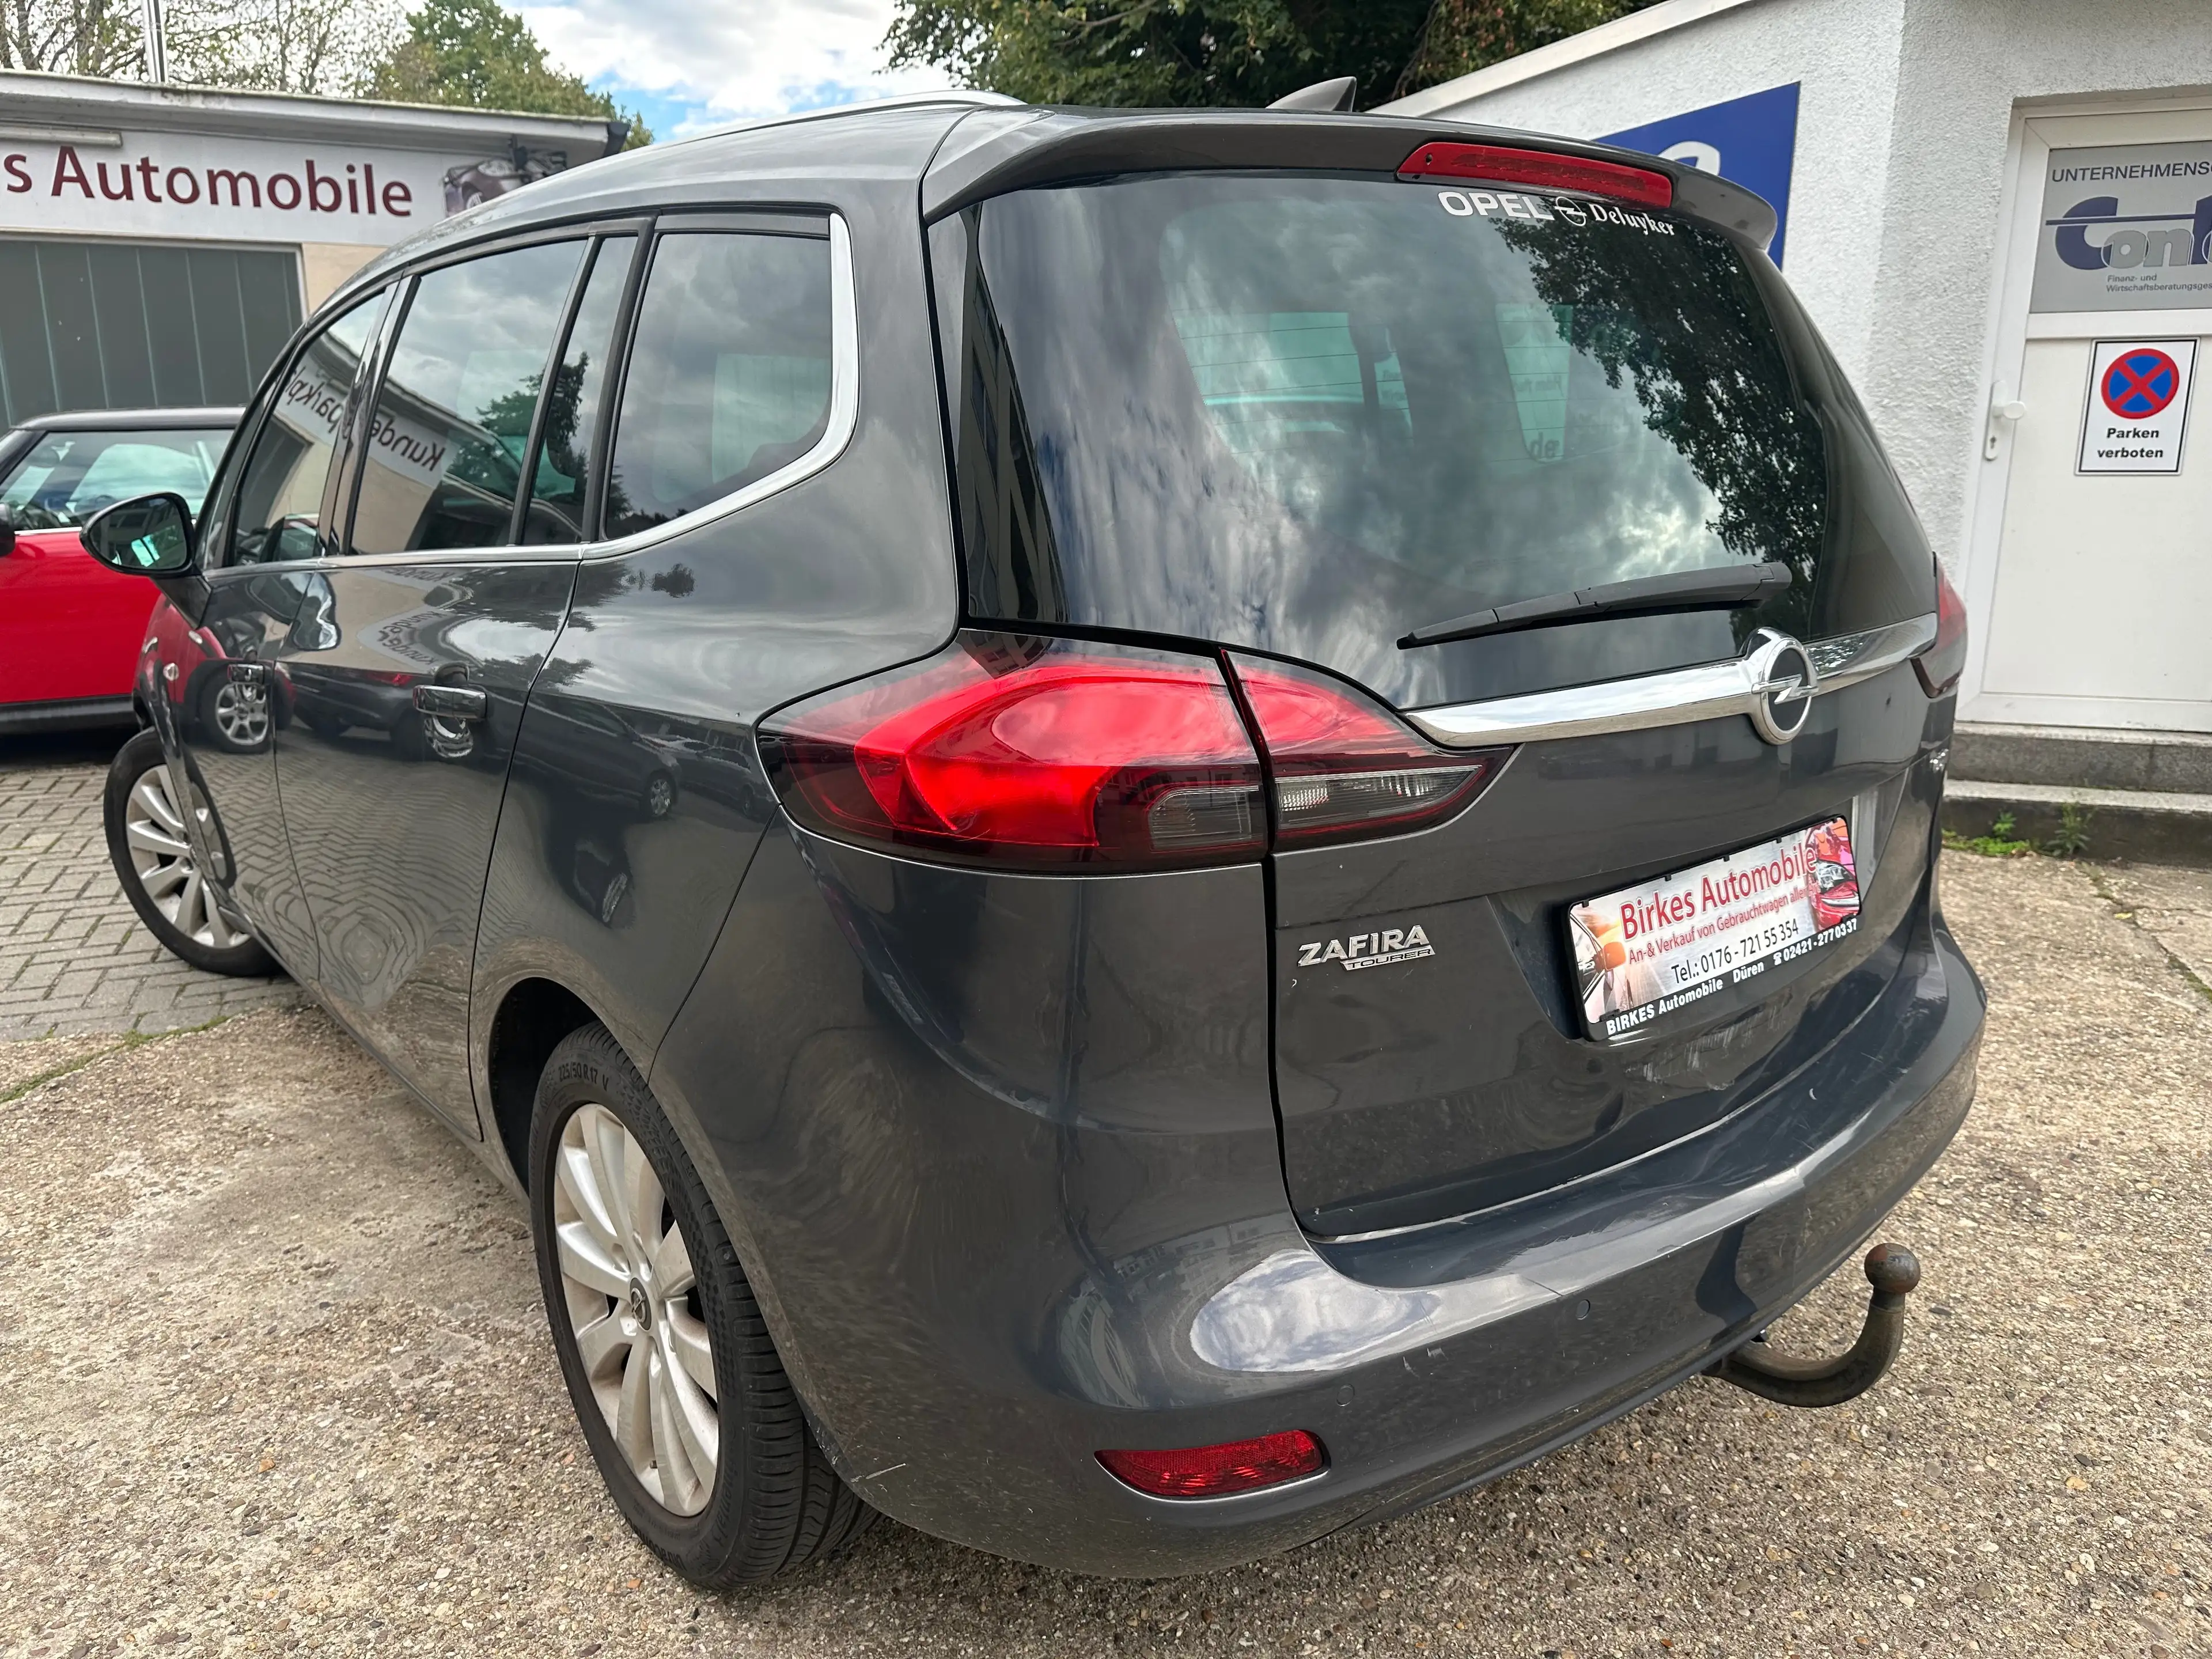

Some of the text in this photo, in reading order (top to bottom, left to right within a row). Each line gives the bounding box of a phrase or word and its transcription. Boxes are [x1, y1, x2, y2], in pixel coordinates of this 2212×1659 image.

[51, 145, 412, 217] Automobile
[2052, 161, 2212, 182] UNTERNEHMENS
[1438, 191, 1675, 236] OPEL Deluyker
[2107, 274, 2157, 283] Finanz- und
[2097, 447, 2164, 458] verboten
[2107, 427, 2160, 438] Parken
[1620, 842, 1816, 940] Birkes Automobile
[1656, 926, 1695, 953] Verkauf
[1697, 923, 1715, 938] von
[1717, 895, 1789, 931] Gebrauchtwagen
[1297, 925, 1430, 967] ZAFIRA
[1347, 949, 1431, 968] TOURER
[1672, 959, 1699, 984] Tel.:
[1700, 945, 1732, 973] 0176
[1740, 934, 1762, 957] 721
[1764, 927, 1777, 948] 55
[1779, 918, 1798, 941] 354
[1606, 1003, 1655, 1036] BIRKES
[1658, 978, 1724, 1014] Automobile
[1733, 961, 1764, 983] Düren
[603, 1074, 609, 1092] V
